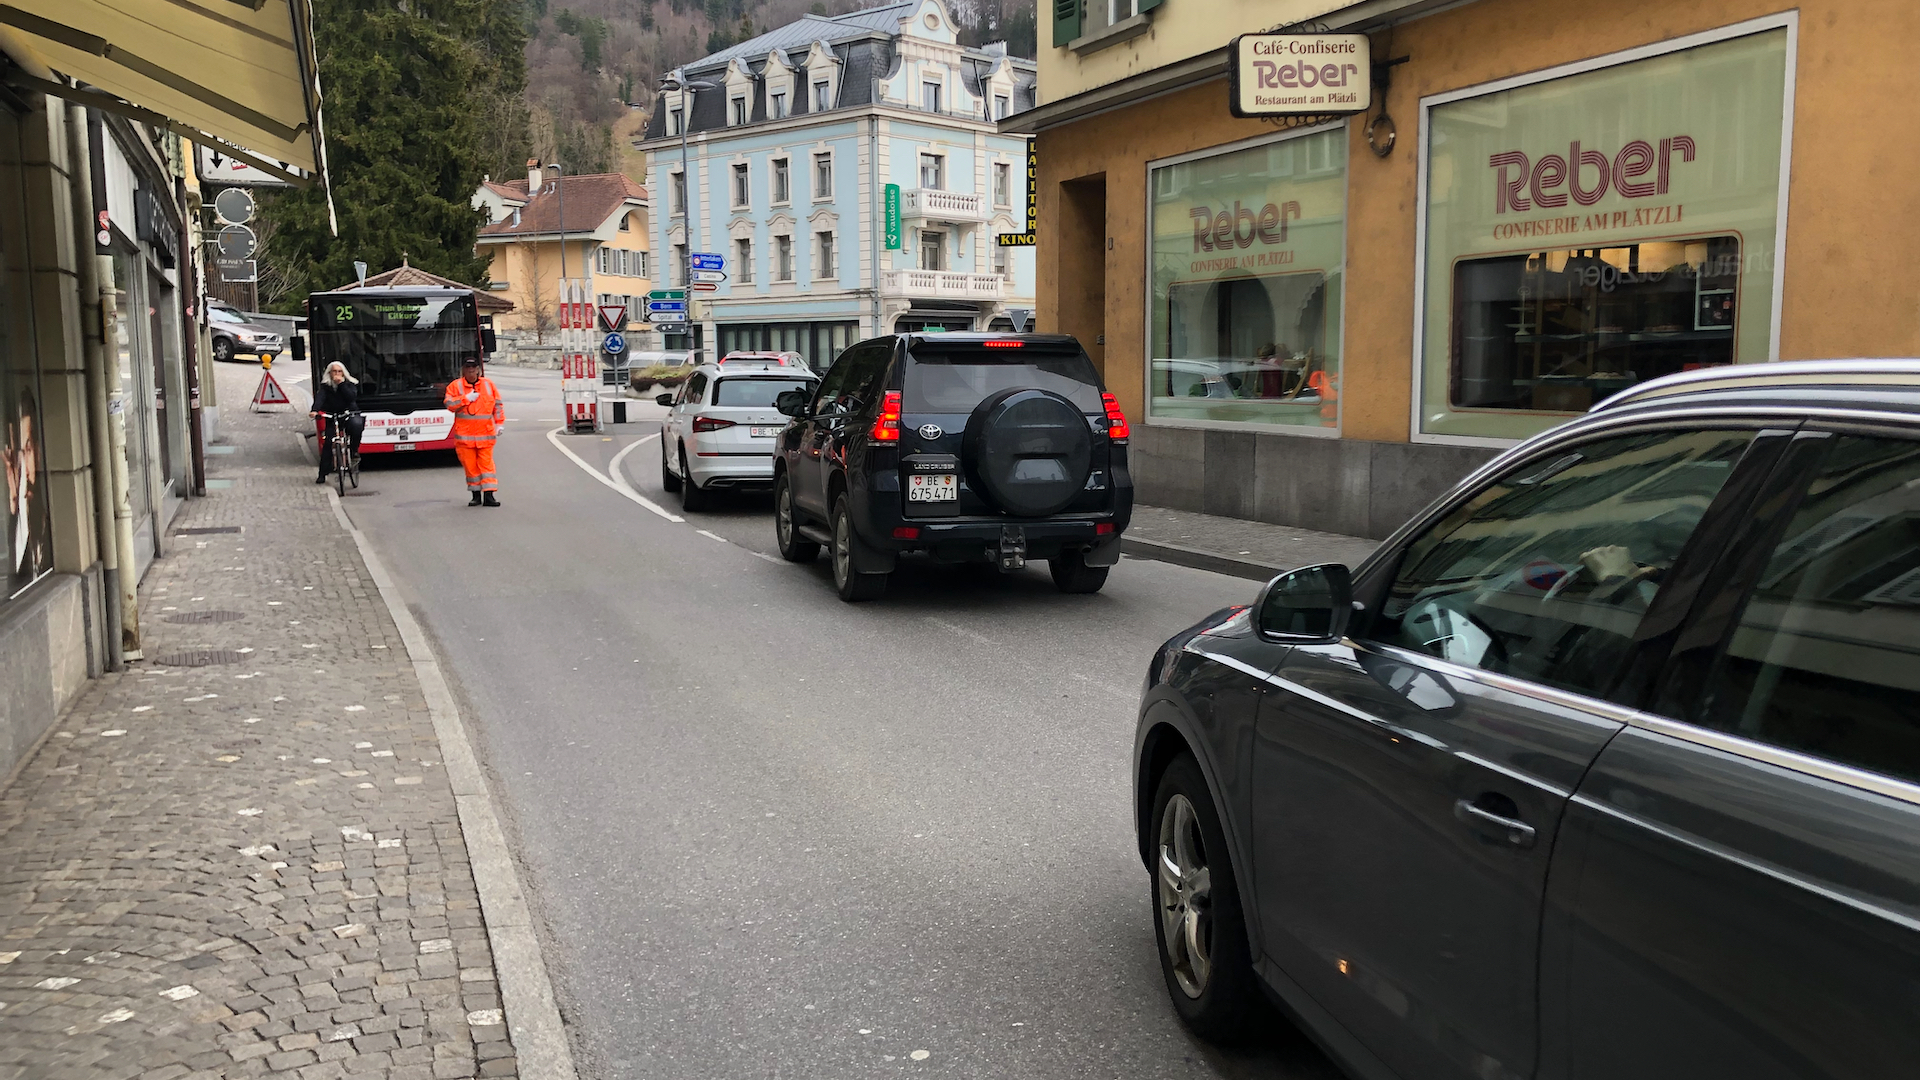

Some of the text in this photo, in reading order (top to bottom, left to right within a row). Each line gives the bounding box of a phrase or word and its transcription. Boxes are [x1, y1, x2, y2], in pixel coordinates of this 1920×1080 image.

[1253, 40, 1356, 55] Café-Confiserie
[1253, 60, 1358, 88] Reber
[1255, 92, 1357, 105] Restaurant am Plätzli
[1489, 135, 1696, 214] Reber
[1189, 200, 1301, 253] Reber
[1493, 204, 1684, 240] CONFISERIE AM PLÄTZLI
[1000, 234, 1037, 245] KINO
[1190, 250, 1294, 273] CONFISERIE AM PLÄTZLI
[336, 305, 354, 321] 25
[374, 304, 395, 312] Thun
[369, 419, 385, 427] THUN
[388, 418, 411, 426] BERNER
[413, 417, 445, 425] OBERLAND
[386, 426, 421, 436] MAN
[927, 476, 939, 486] BE
[910, 487, 955, 500] 675 471
